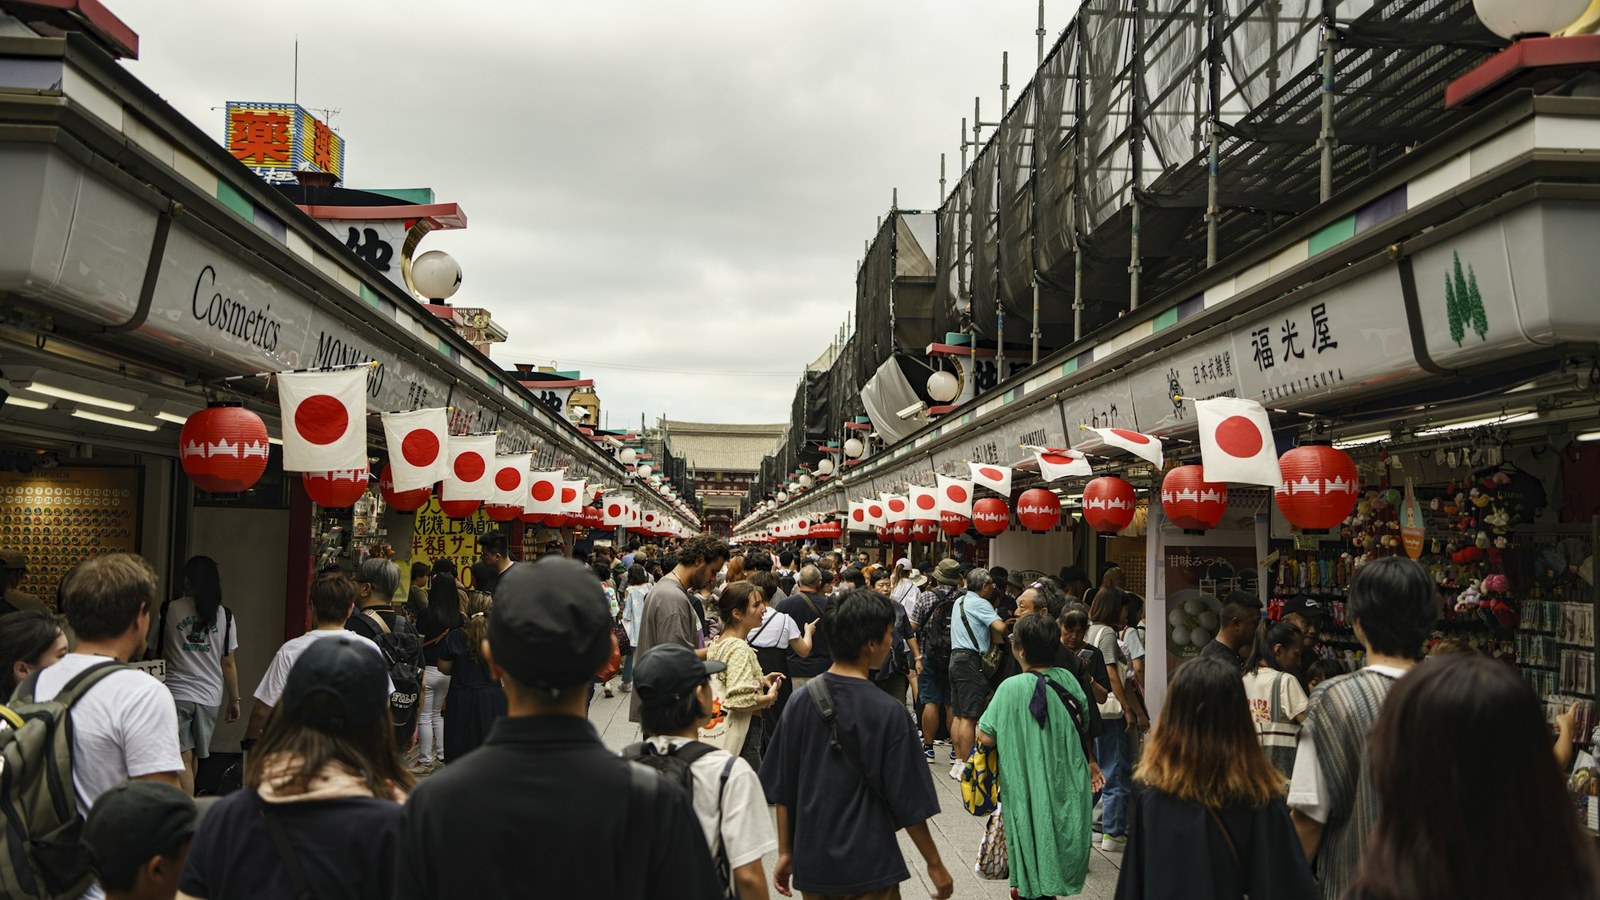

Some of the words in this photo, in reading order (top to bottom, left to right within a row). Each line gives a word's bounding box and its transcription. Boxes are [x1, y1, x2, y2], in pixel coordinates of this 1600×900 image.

[230, 111, 290, 163] 薬
[313, 119, 332, 172] 薬
[192, 265, 281, 352] Cosmetics
[1251, 302, 1338, 372] 福光屋
[1192, 350, 1233, 385] 日本式雑貨
[1168, 554, 1227, 568] 甘味みつや
